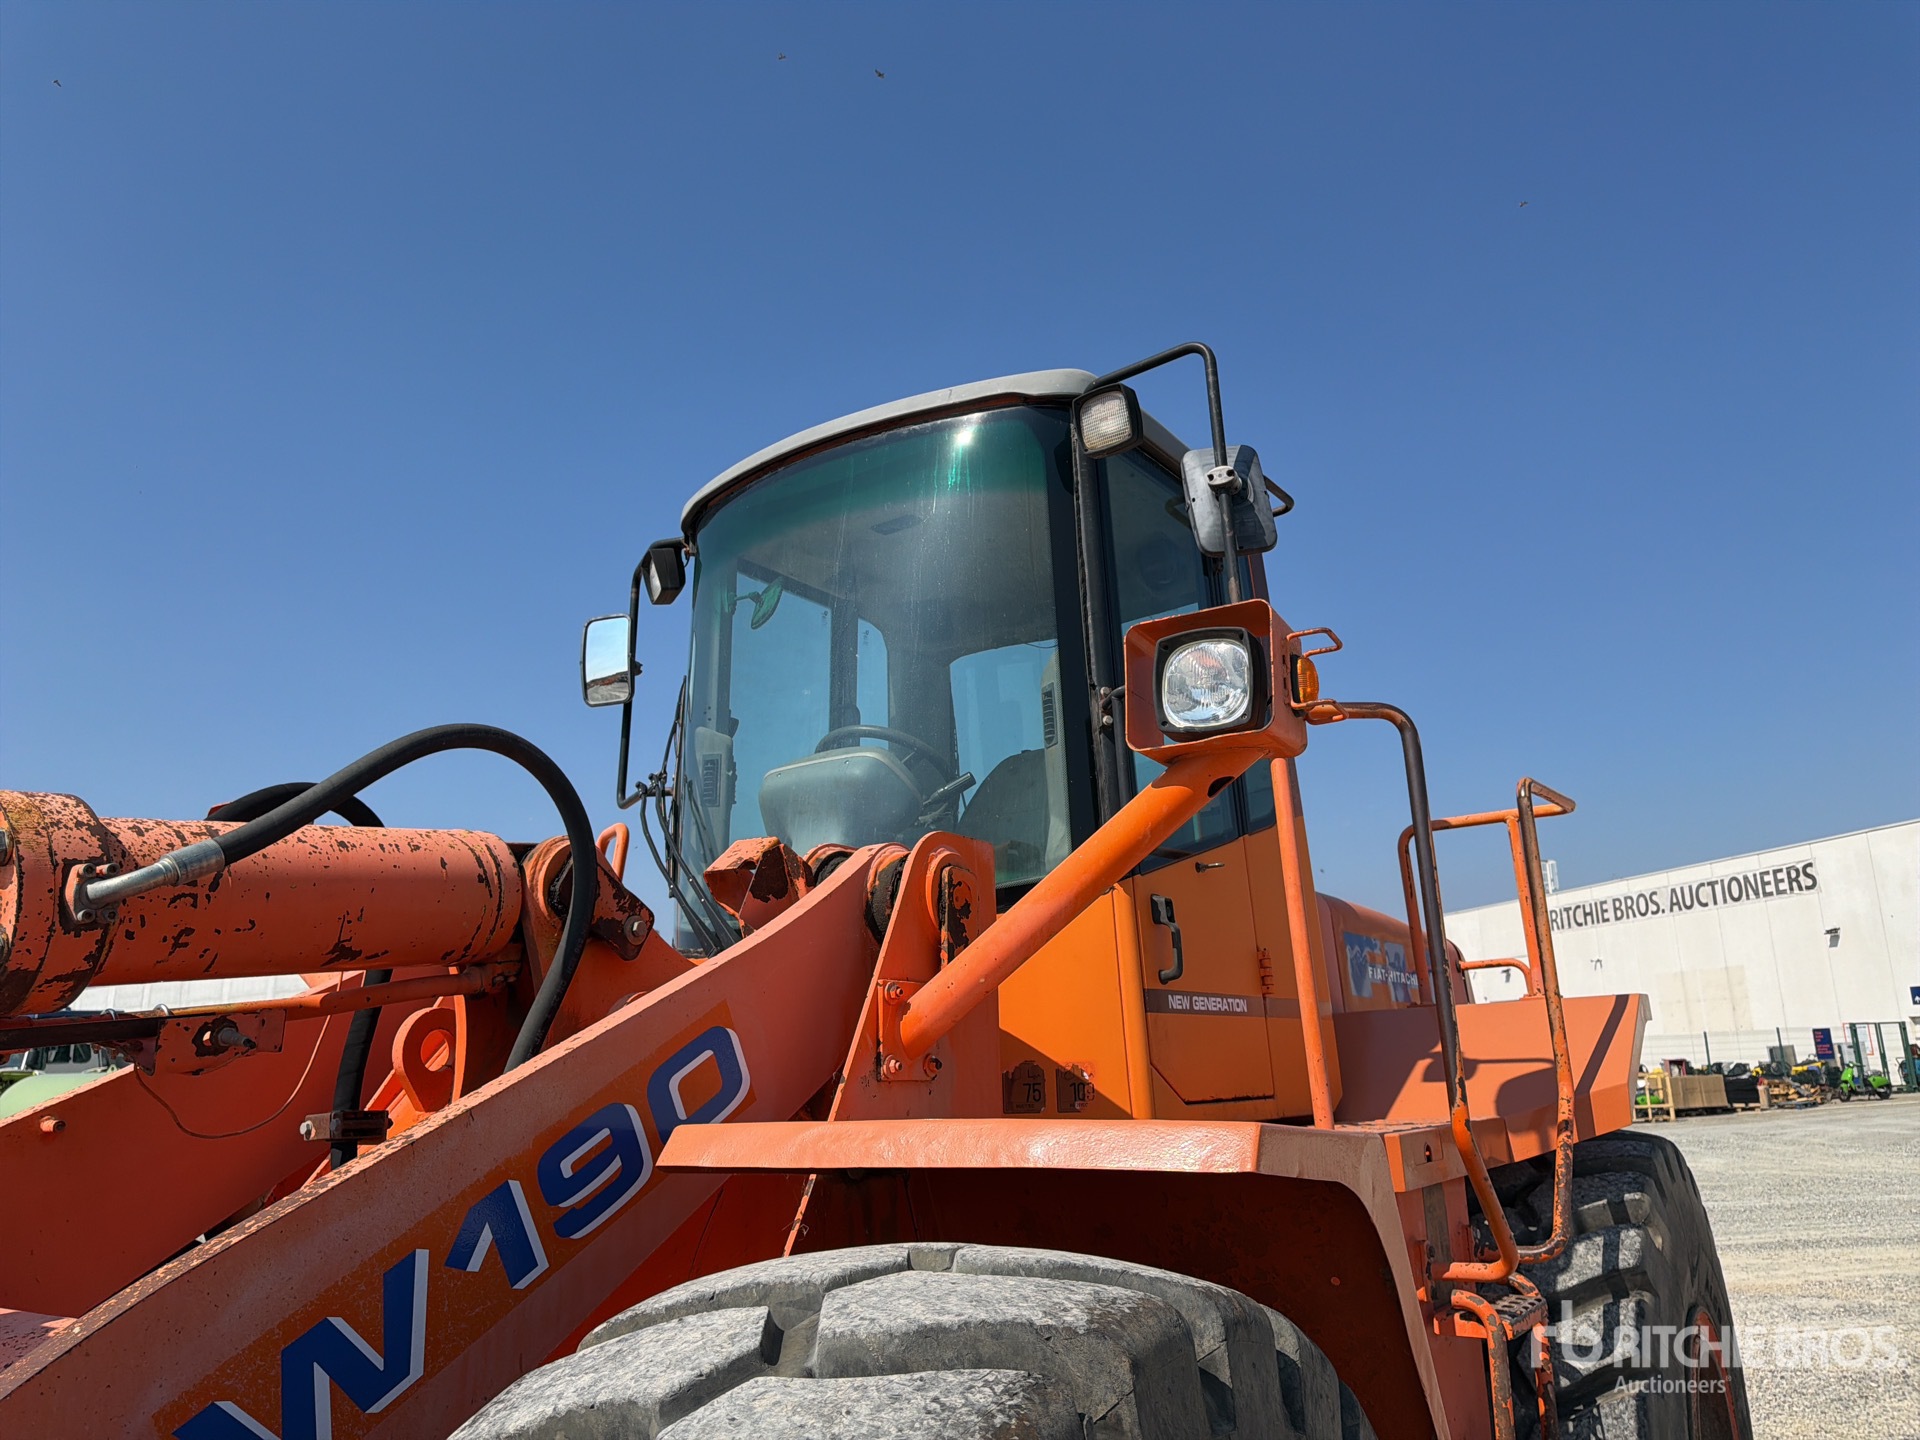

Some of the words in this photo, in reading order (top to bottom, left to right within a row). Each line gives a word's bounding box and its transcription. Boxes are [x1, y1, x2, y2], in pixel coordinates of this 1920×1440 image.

[1549, 899, 1610, 931] RITCHIE
[1612, 891, 1666, 921] BROS.
[1669, 862, 1818, 912] AUCTIONEERS
[1167, 994, 1190, 1010] NEW
[1192, 996, 1248, 1013] GENERATION
[1022, 1082, 1042, 1103] 75
[173, 1025, 751, 1440] W190
